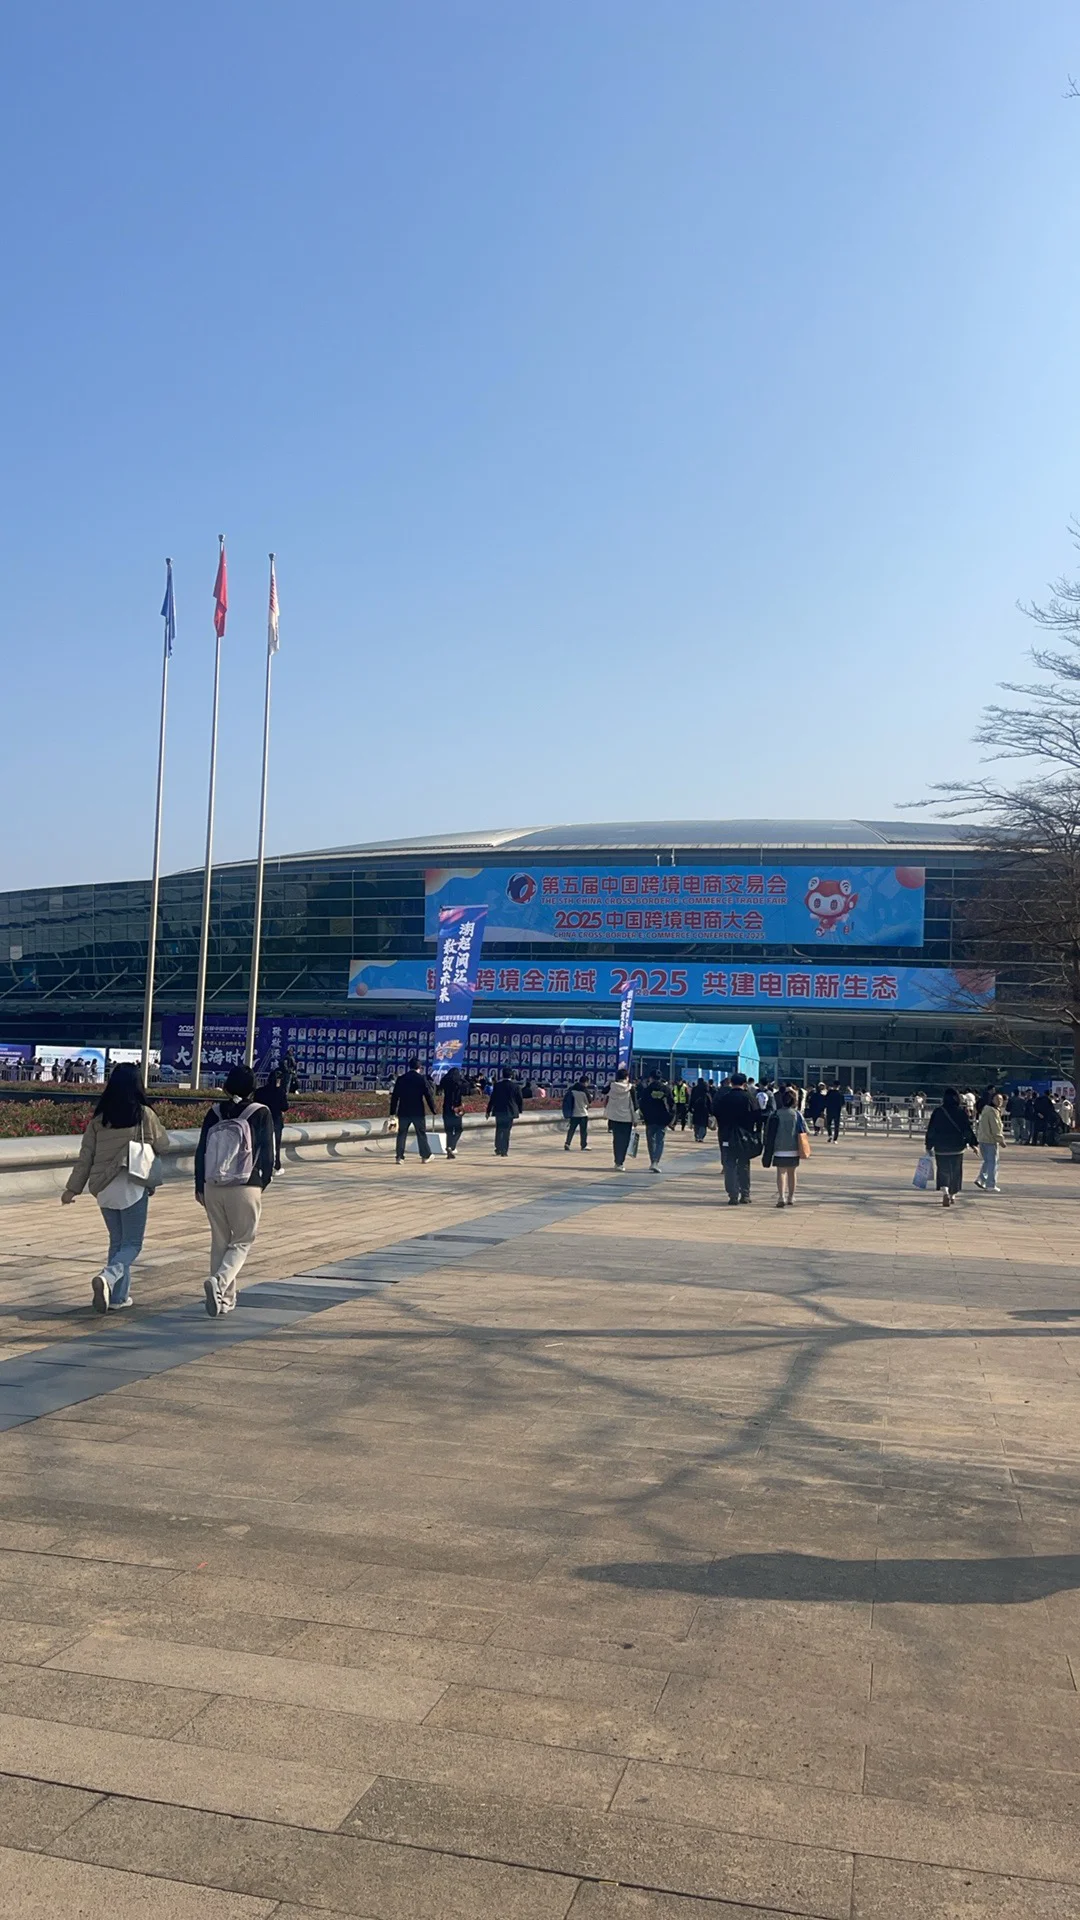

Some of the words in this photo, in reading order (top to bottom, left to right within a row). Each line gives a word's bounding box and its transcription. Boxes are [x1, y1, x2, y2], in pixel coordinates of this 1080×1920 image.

[541, 875, 787, 895] 第五届中国跨境电商交易会
[541, 897, 556, 905] THE
[575, 897, 602, 905] CHINA
[736, 897, 765, 905] TRADE
[766, 897, 788, 905] FAIR
[555, 911, 602, 929] 2025
[605, 911, 763, 930] 中国跨境电商大会
[553, 931, 577, 939] CHINA
[693, 931, 744, 939] CONFERENCE
[745, 931, 765, 939] 2025
[427, 967, 597, 993] 跨境全流域
[609, 968, 689, 998] 2025
[702, 971, 899, 1001] 共建电商新生态
